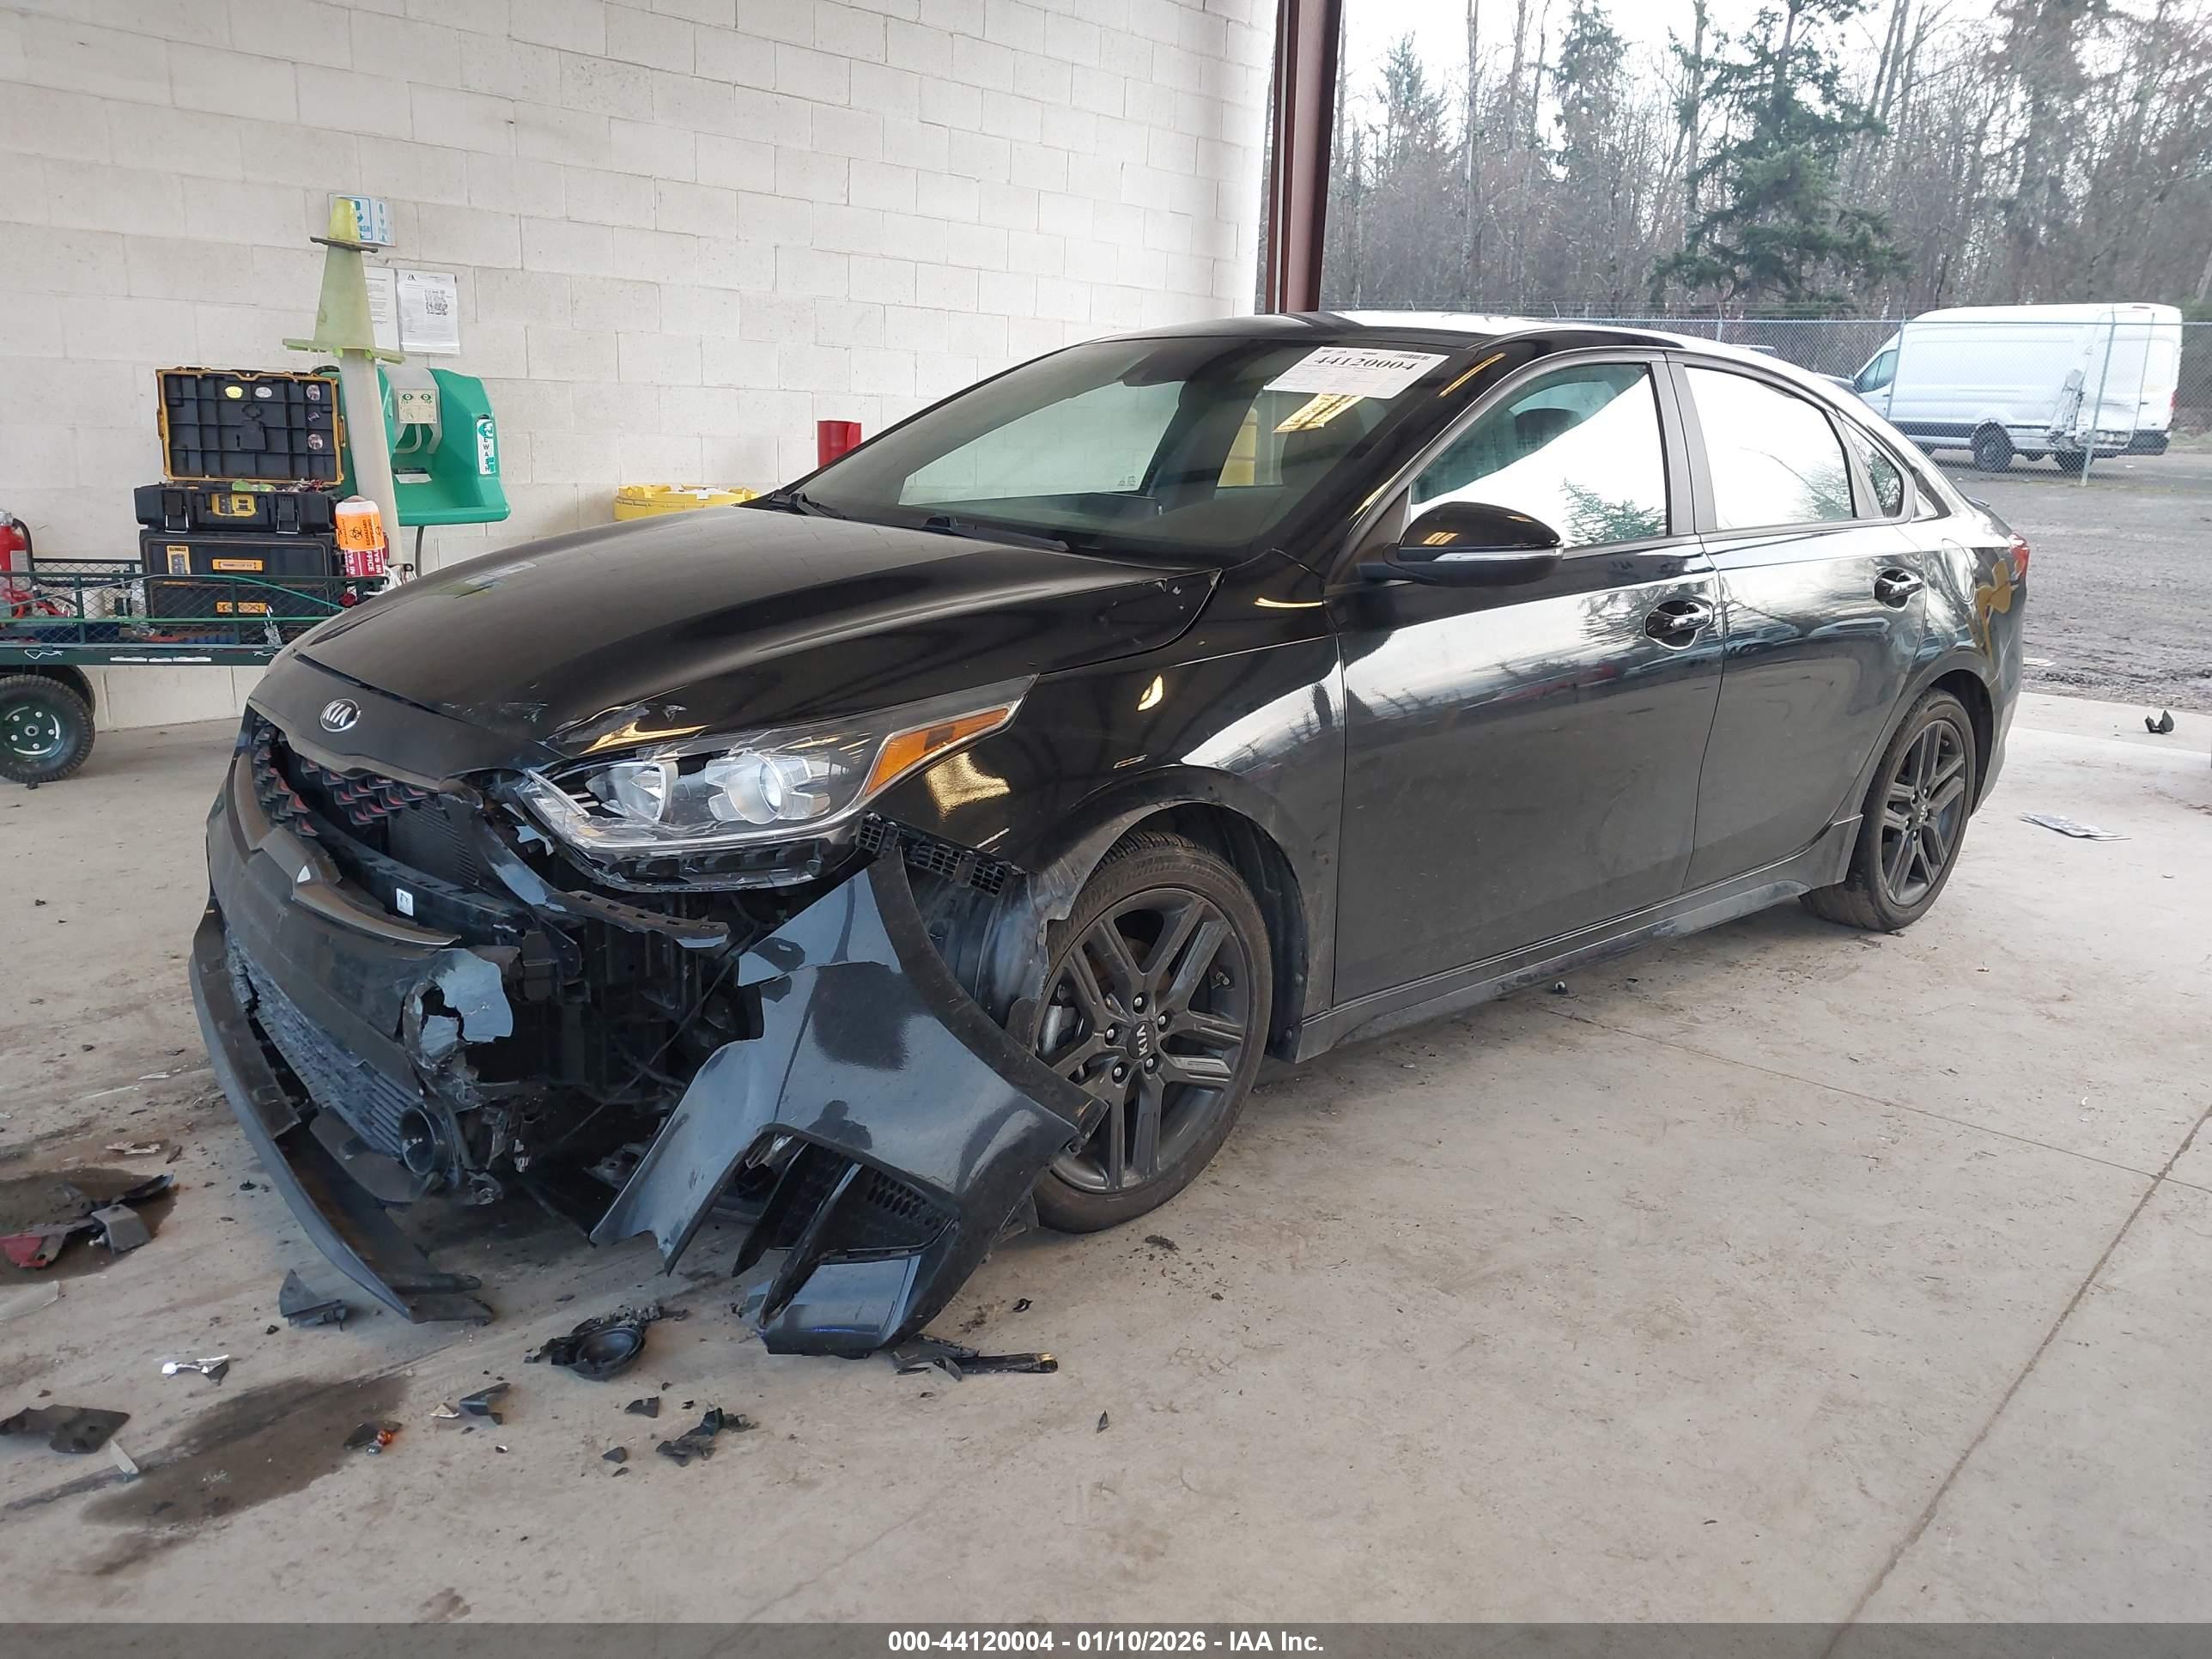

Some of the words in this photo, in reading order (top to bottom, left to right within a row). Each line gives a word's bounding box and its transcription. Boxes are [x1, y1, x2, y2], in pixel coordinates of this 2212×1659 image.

[1314, 356, 1418, 370] 44120004
[366, 550, 375, 573] FFICE
[322, 702, 352, 726] KIA
[1136, 1024, 1148, 1057] KIA
